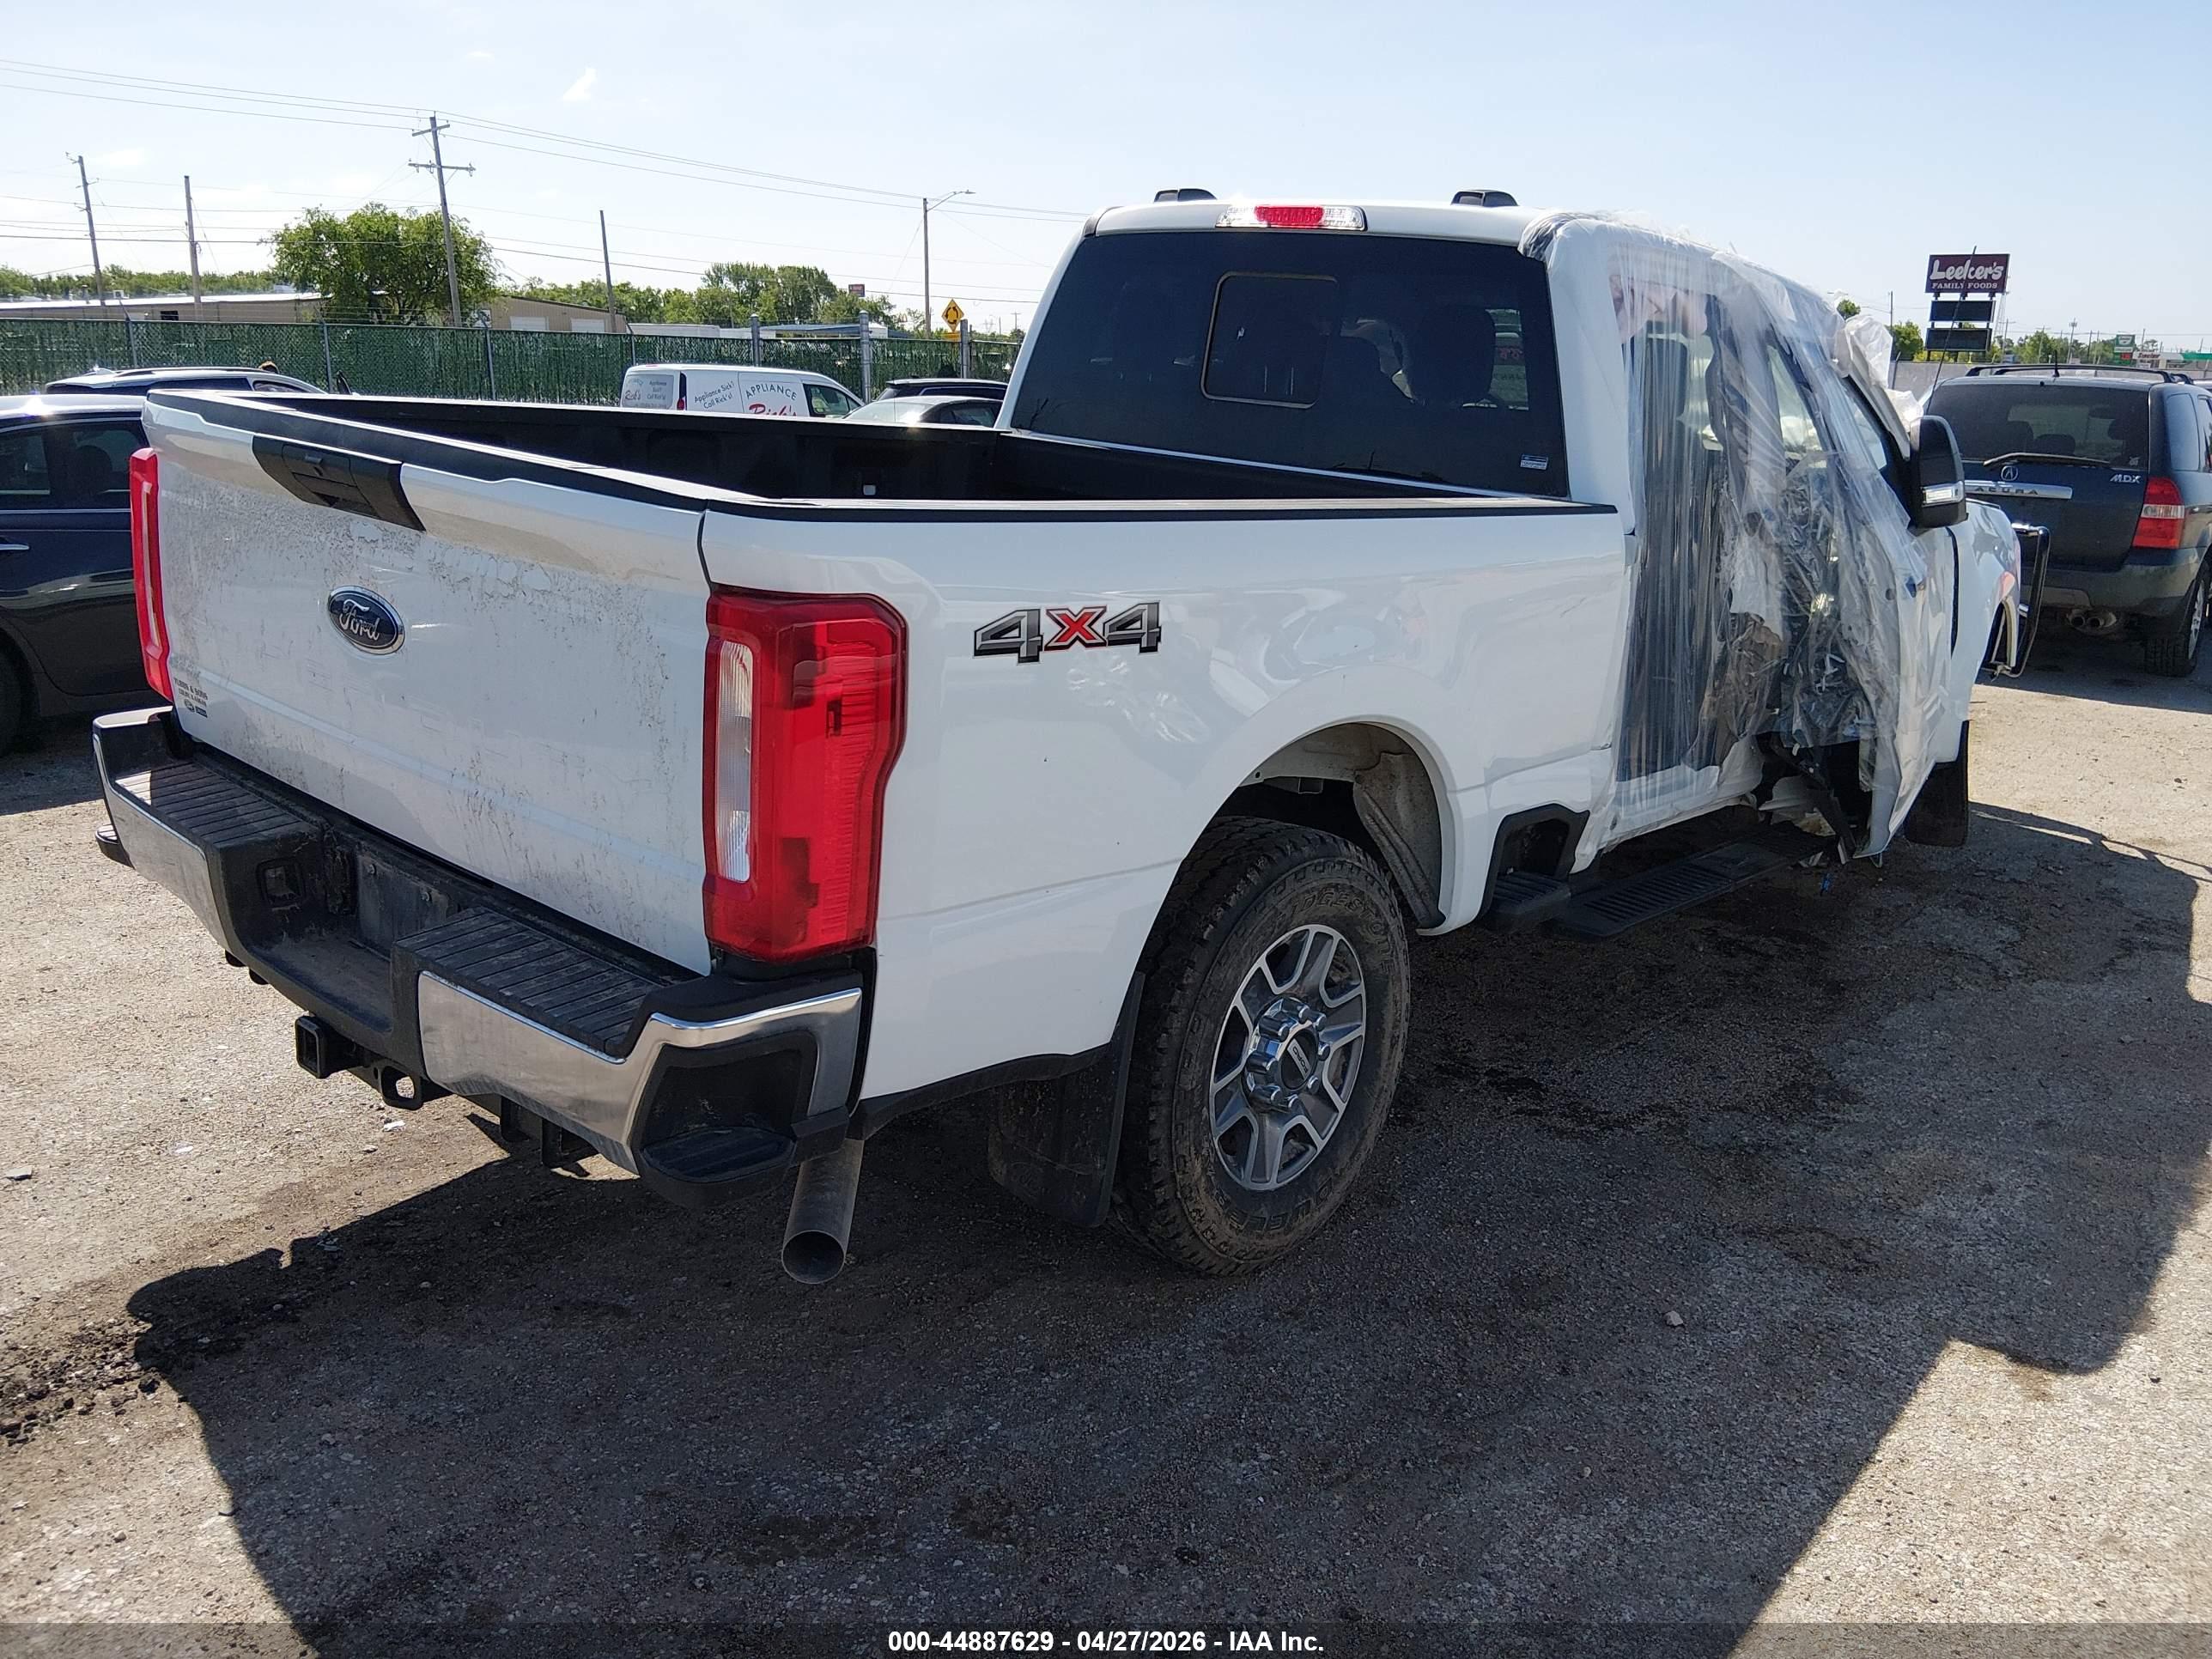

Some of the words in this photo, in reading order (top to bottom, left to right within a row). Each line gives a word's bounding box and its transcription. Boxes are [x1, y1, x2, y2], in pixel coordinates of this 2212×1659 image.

[1929, 259, 2004, 280] Leeker's
[694, 389, 721, 403] Appliance
[745, 384, 797, 401] APPLIANCE
[2110, 473, 2142, 484] MDX
[1975, 486, 2039, 495] ACURA
[338, 599, 383, 641] Ford
[1292, 1046, 1310, 1073] FORD
